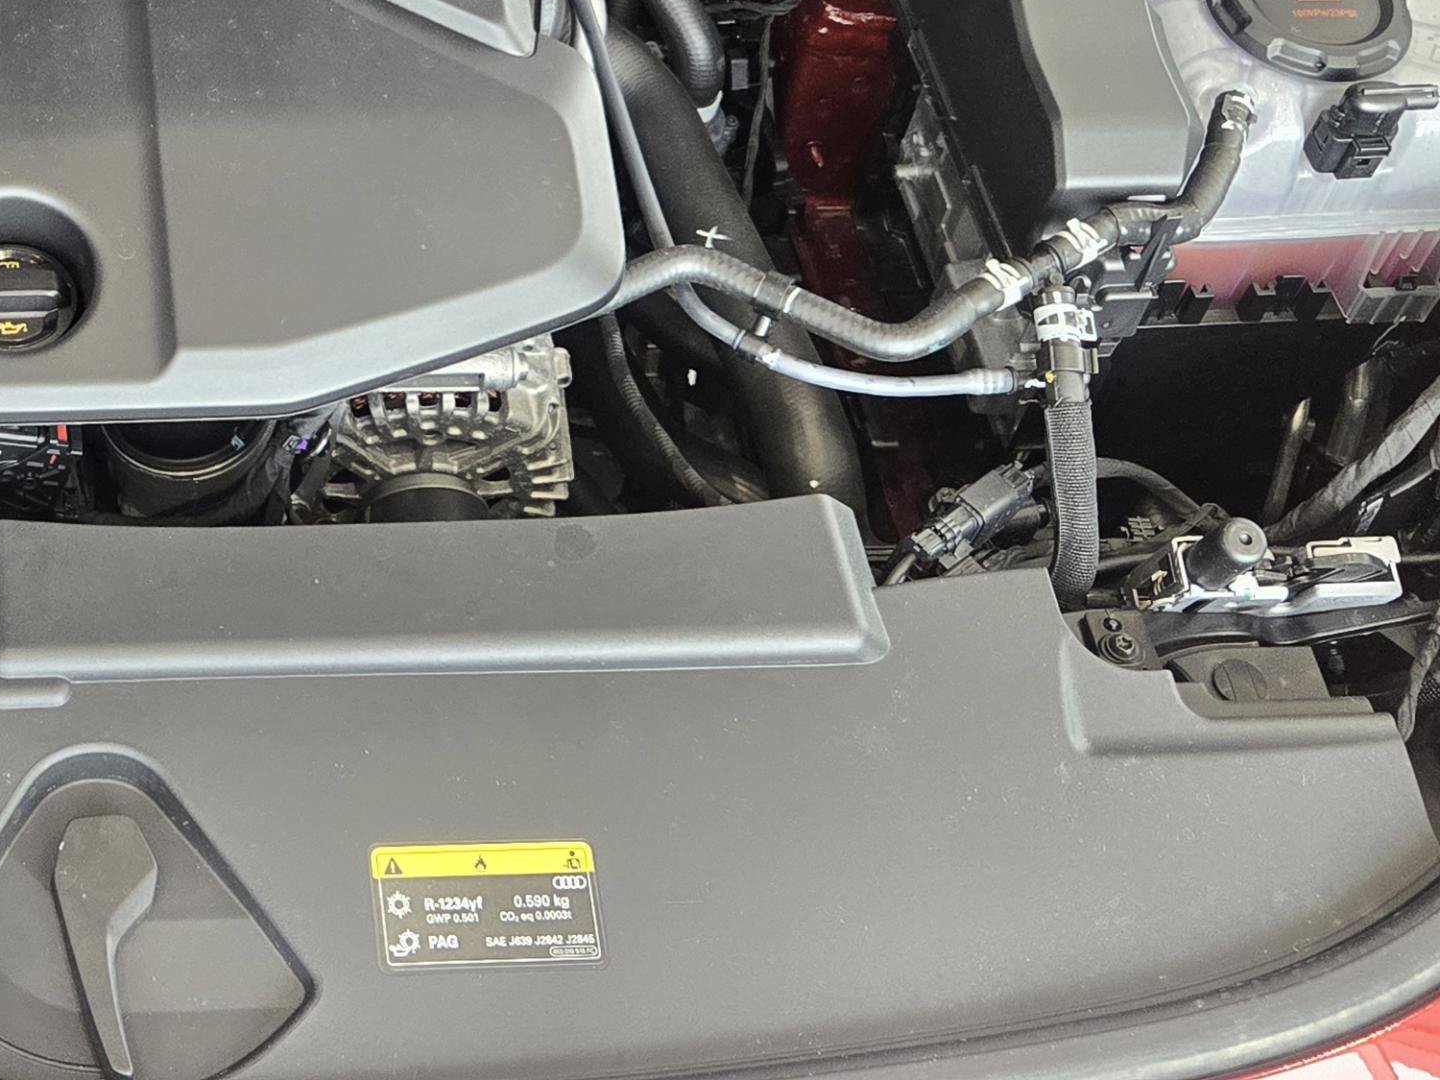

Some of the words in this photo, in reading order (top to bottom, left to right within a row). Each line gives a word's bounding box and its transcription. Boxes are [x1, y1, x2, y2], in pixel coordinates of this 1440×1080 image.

[424, 895, 483, 911] R-1234yf
[513, 894, 550, 908] 0.590
[554, 894, 570, 909] kg
[426, 914, 451, 924] GWP
[453, 913, 479, 923] 0.501
[520, 912, 534, 922] eq
[428, 935, 459, 949] PAG
[486, 936, 507, 947] SAE
[508, 935, 532, 946] J639
